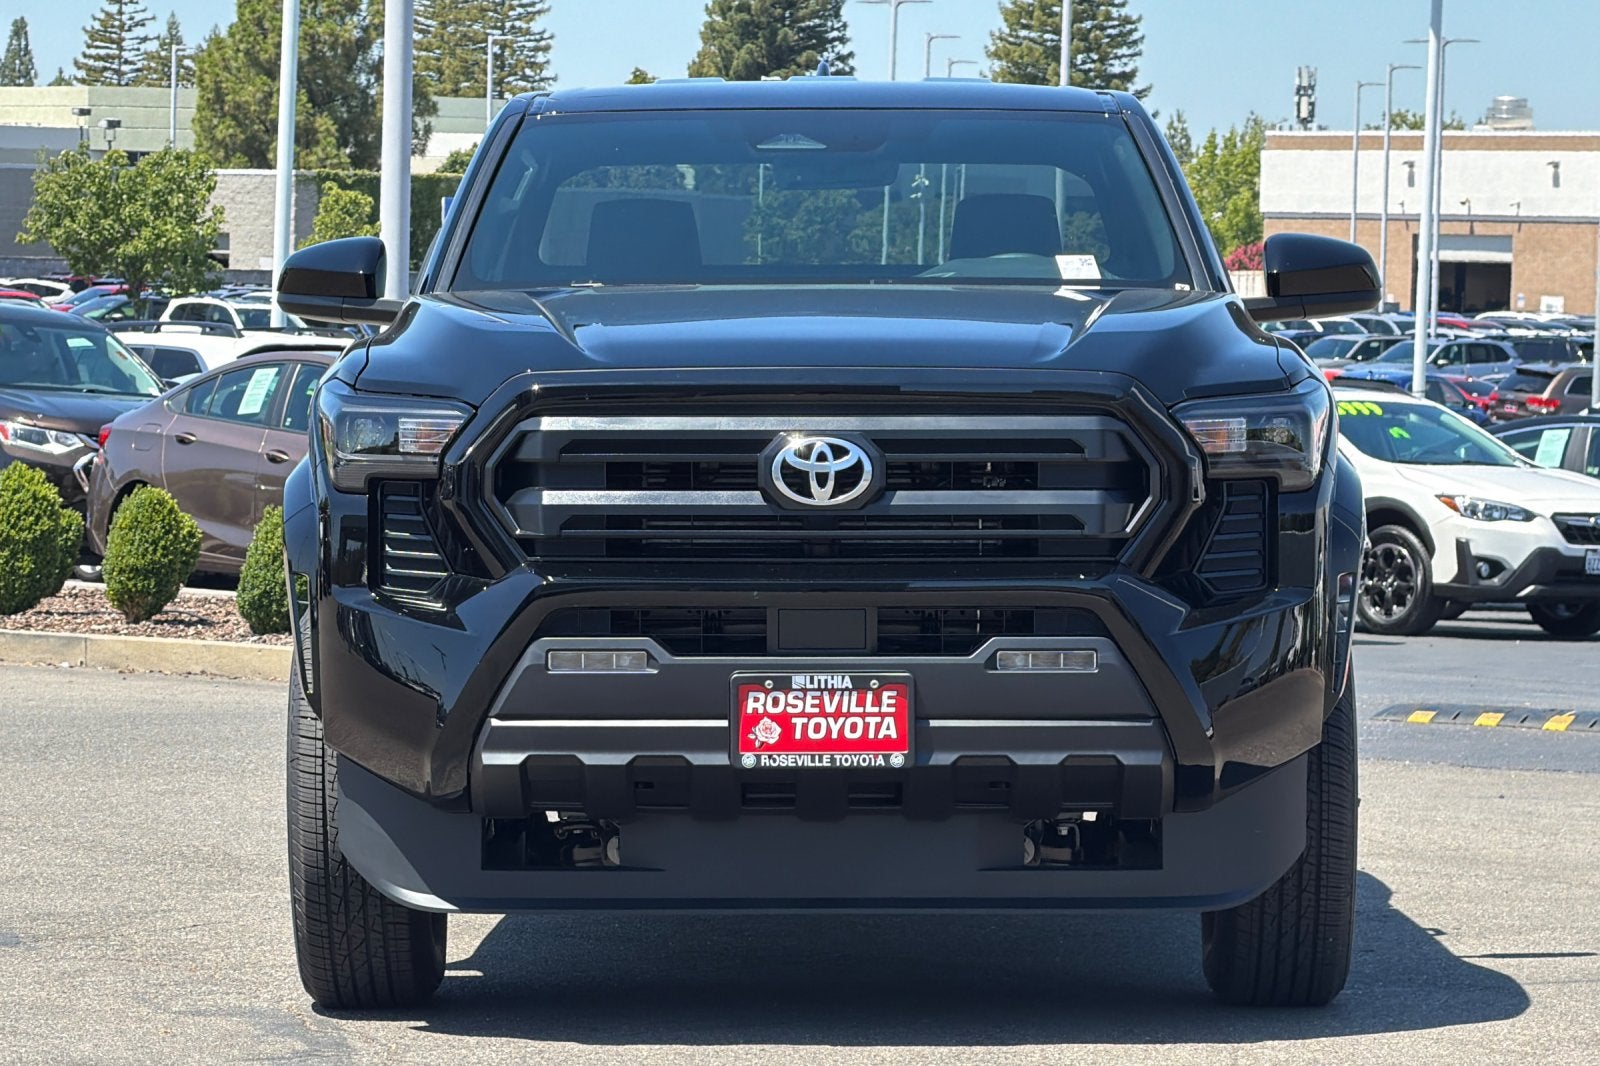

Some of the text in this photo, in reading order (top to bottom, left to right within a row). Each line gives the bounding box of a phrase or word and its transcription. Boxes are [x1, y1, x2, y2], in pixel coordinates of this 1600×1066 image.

[806, 676, 852, 689] LITHIA
[747, 691, 897, 714] ROSEVILLE
[792, 716, 898, 739] TOYOTA
[761, 755, 885, 766] ROSEVILLE TOYOTA
